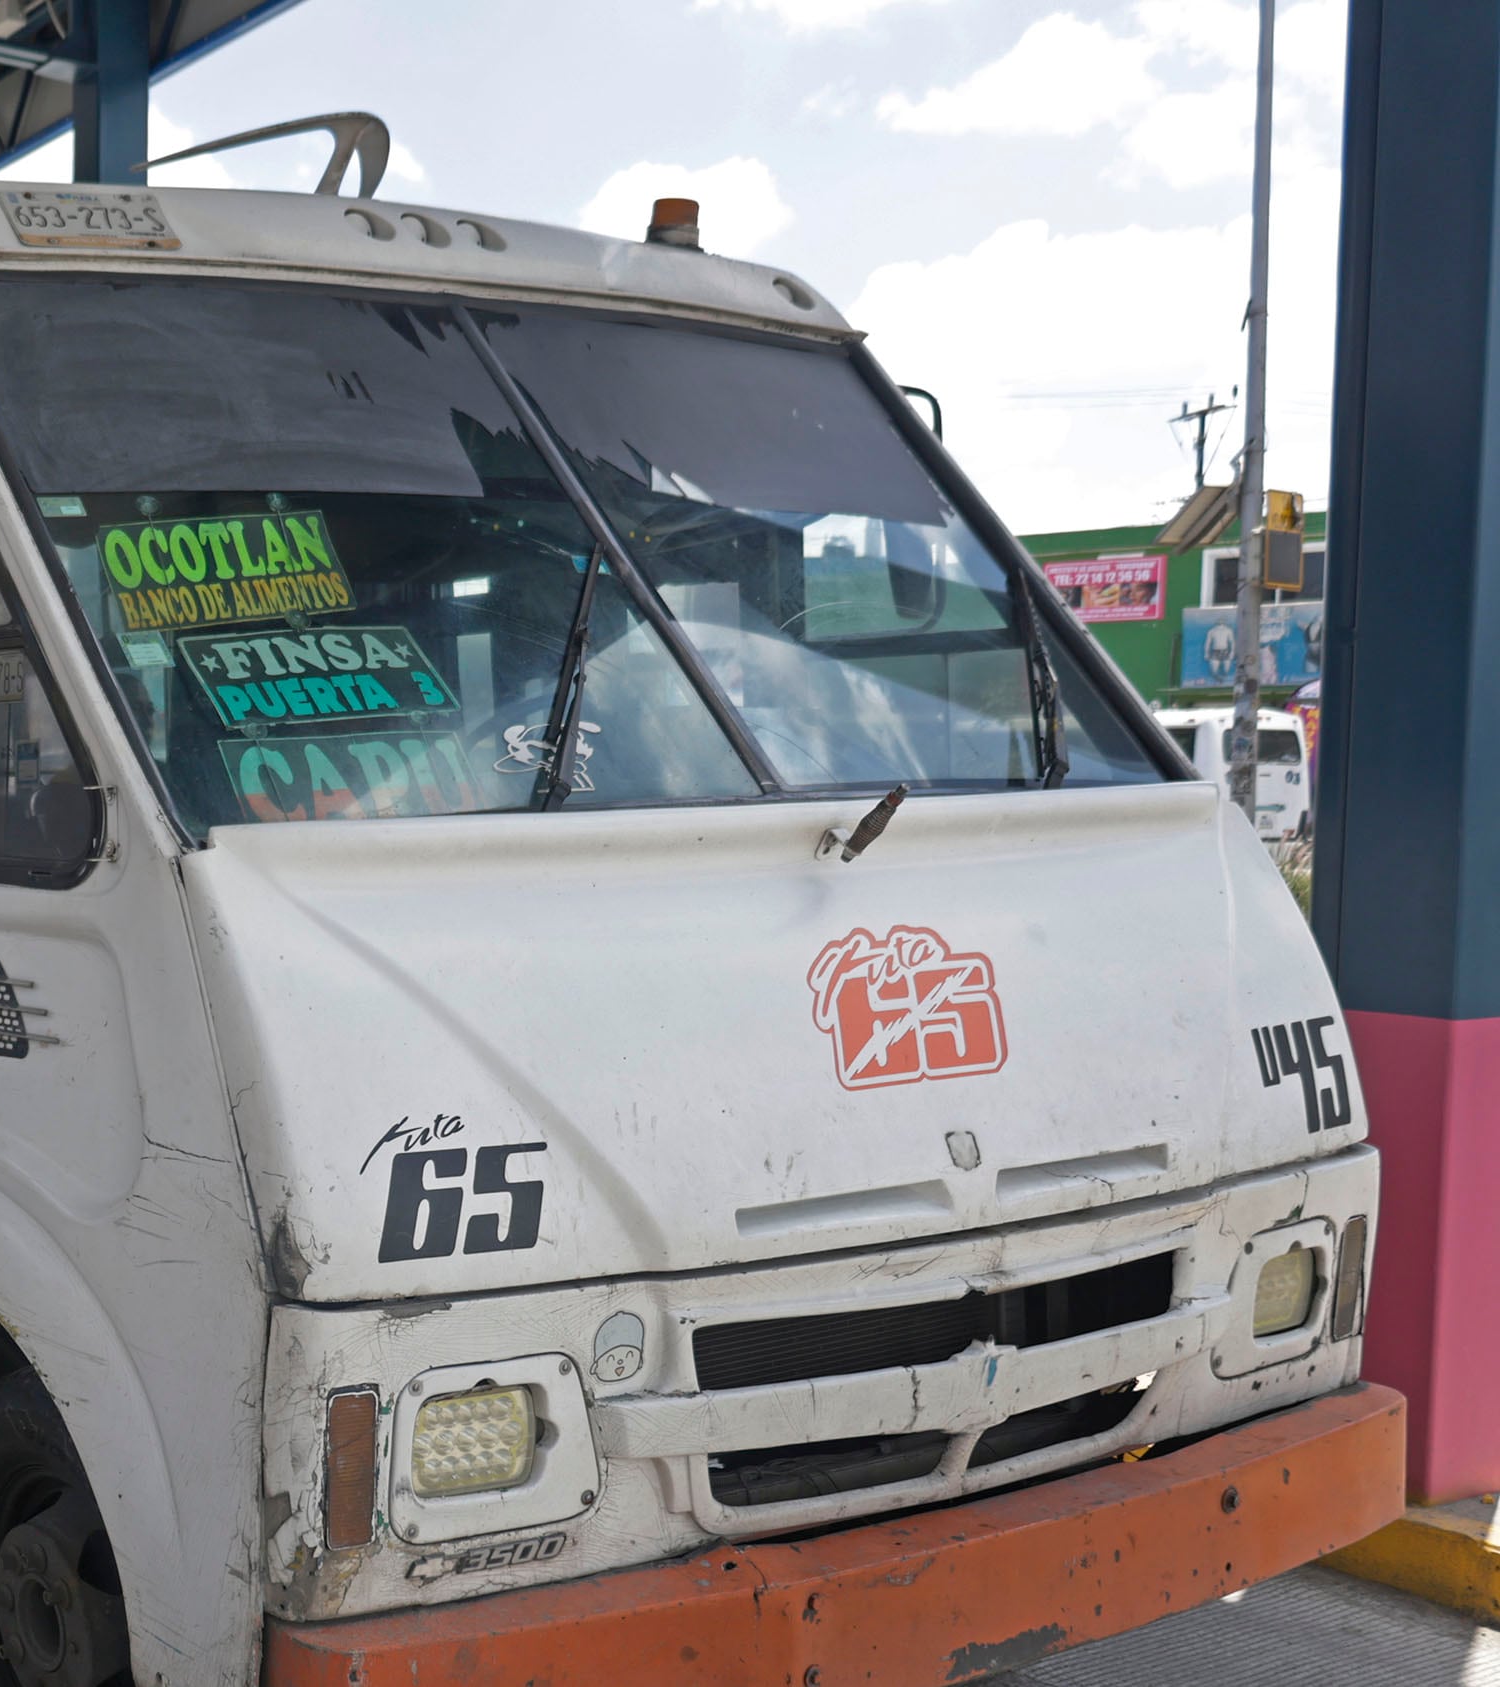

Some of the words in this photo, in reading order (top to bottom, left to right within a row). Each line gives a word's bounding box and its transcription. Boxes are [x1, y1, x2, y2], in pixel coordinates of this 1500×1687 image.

[15, 205, 165, 232] 653-273-S
[103, 515, 333, 589] OCOTLAN
[117, 585, 198, 630] BANCO
[199, 582, 231, 622] DE
[232, 571, 349, 617] ALIMENTOS
[212, 633, 403, 679] FINSA
[217, 673, 398, 723] PUERTA
[412, 671, 445, 705] 3
[238, 737, 480, 822] CAPU
[378, 1141, 548, 1264] 65
